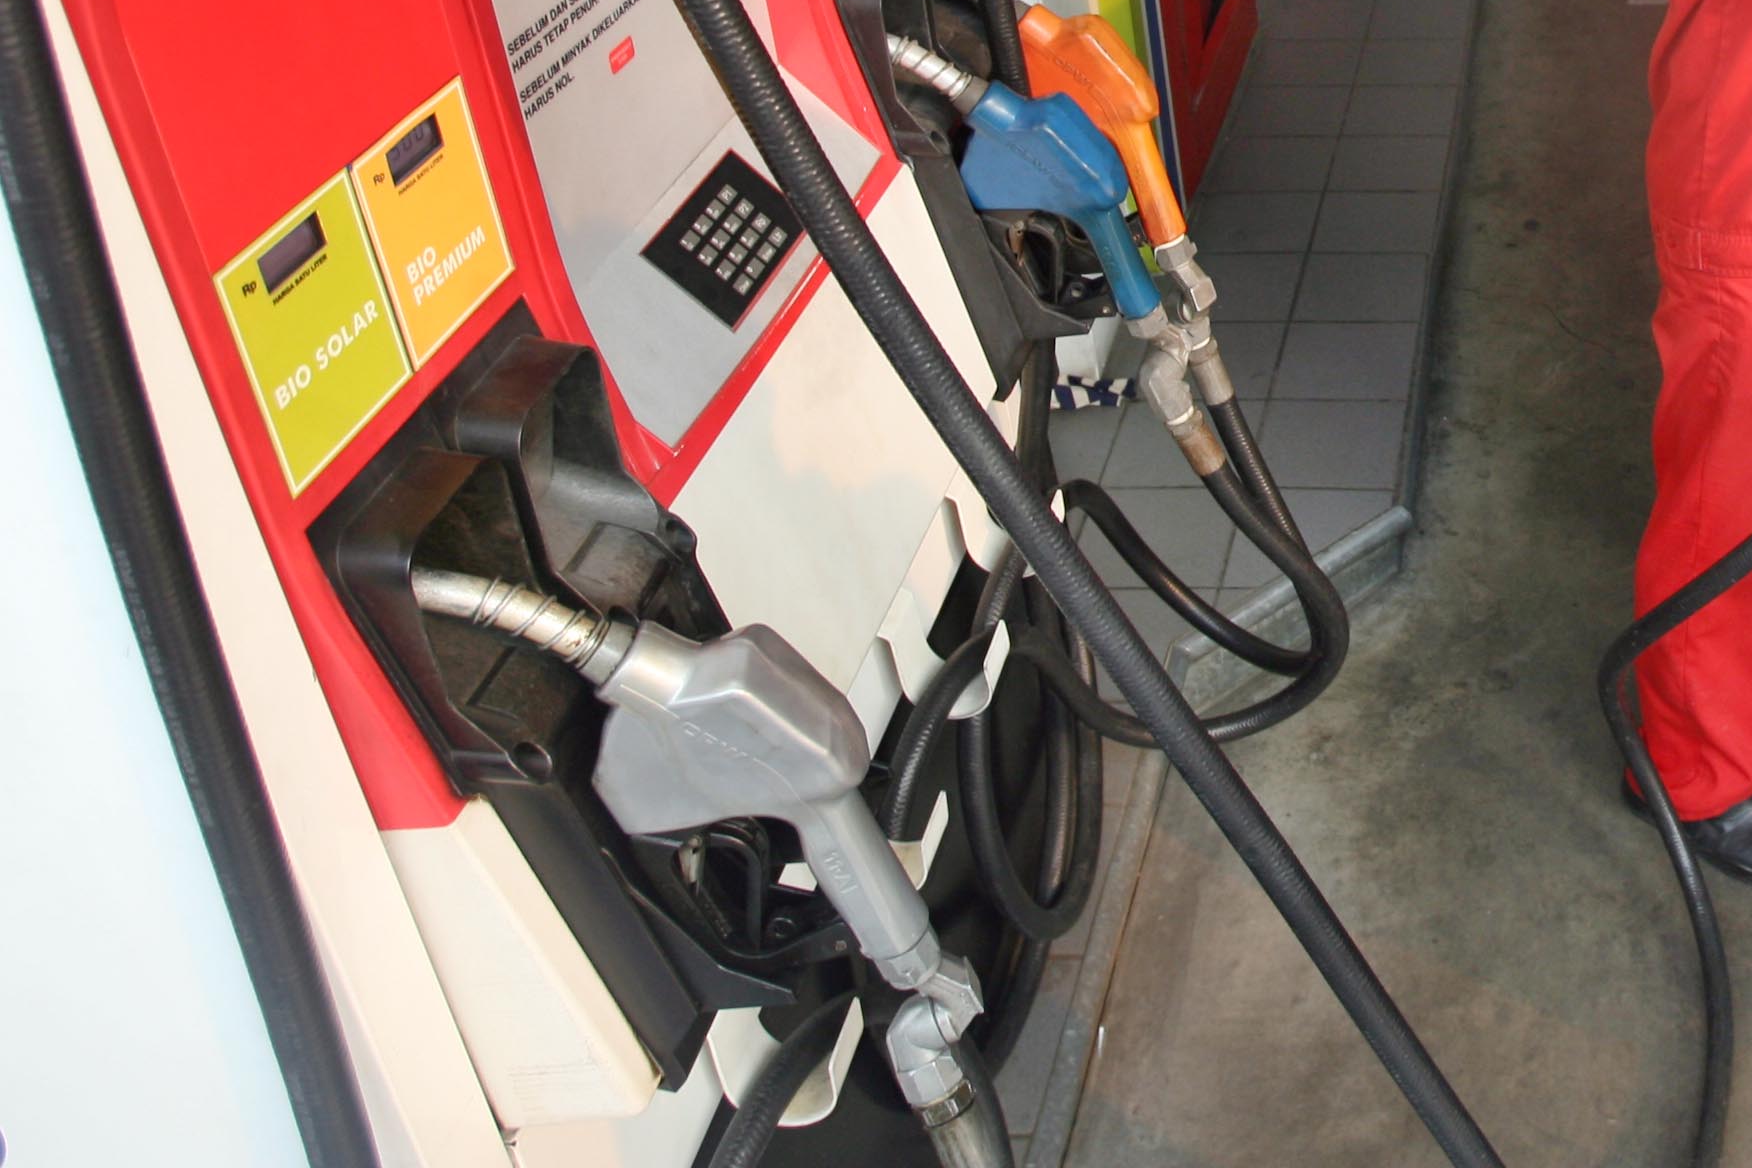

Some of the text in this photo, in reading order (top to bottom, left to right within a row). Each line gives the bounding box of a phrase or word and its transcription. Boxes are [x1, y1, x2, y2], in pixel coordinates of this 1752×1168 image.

[507, 15, 550, 57] SEBELUM
[511, 40, 544, 74] HARUS
[543, 17, 570, 46] TETAP
[519, 60, 561, 104] SEBELUM
[561, 34, 592, 66] MINYAK
[523, 87, 556, 121] HARUS
[241, 280, 257, 298] Rp
[405, 246, 438, 286] BIO
[411, 224, 487, 307] PREMIUM
[274, 298, 380, 411] BIO SOLAR
